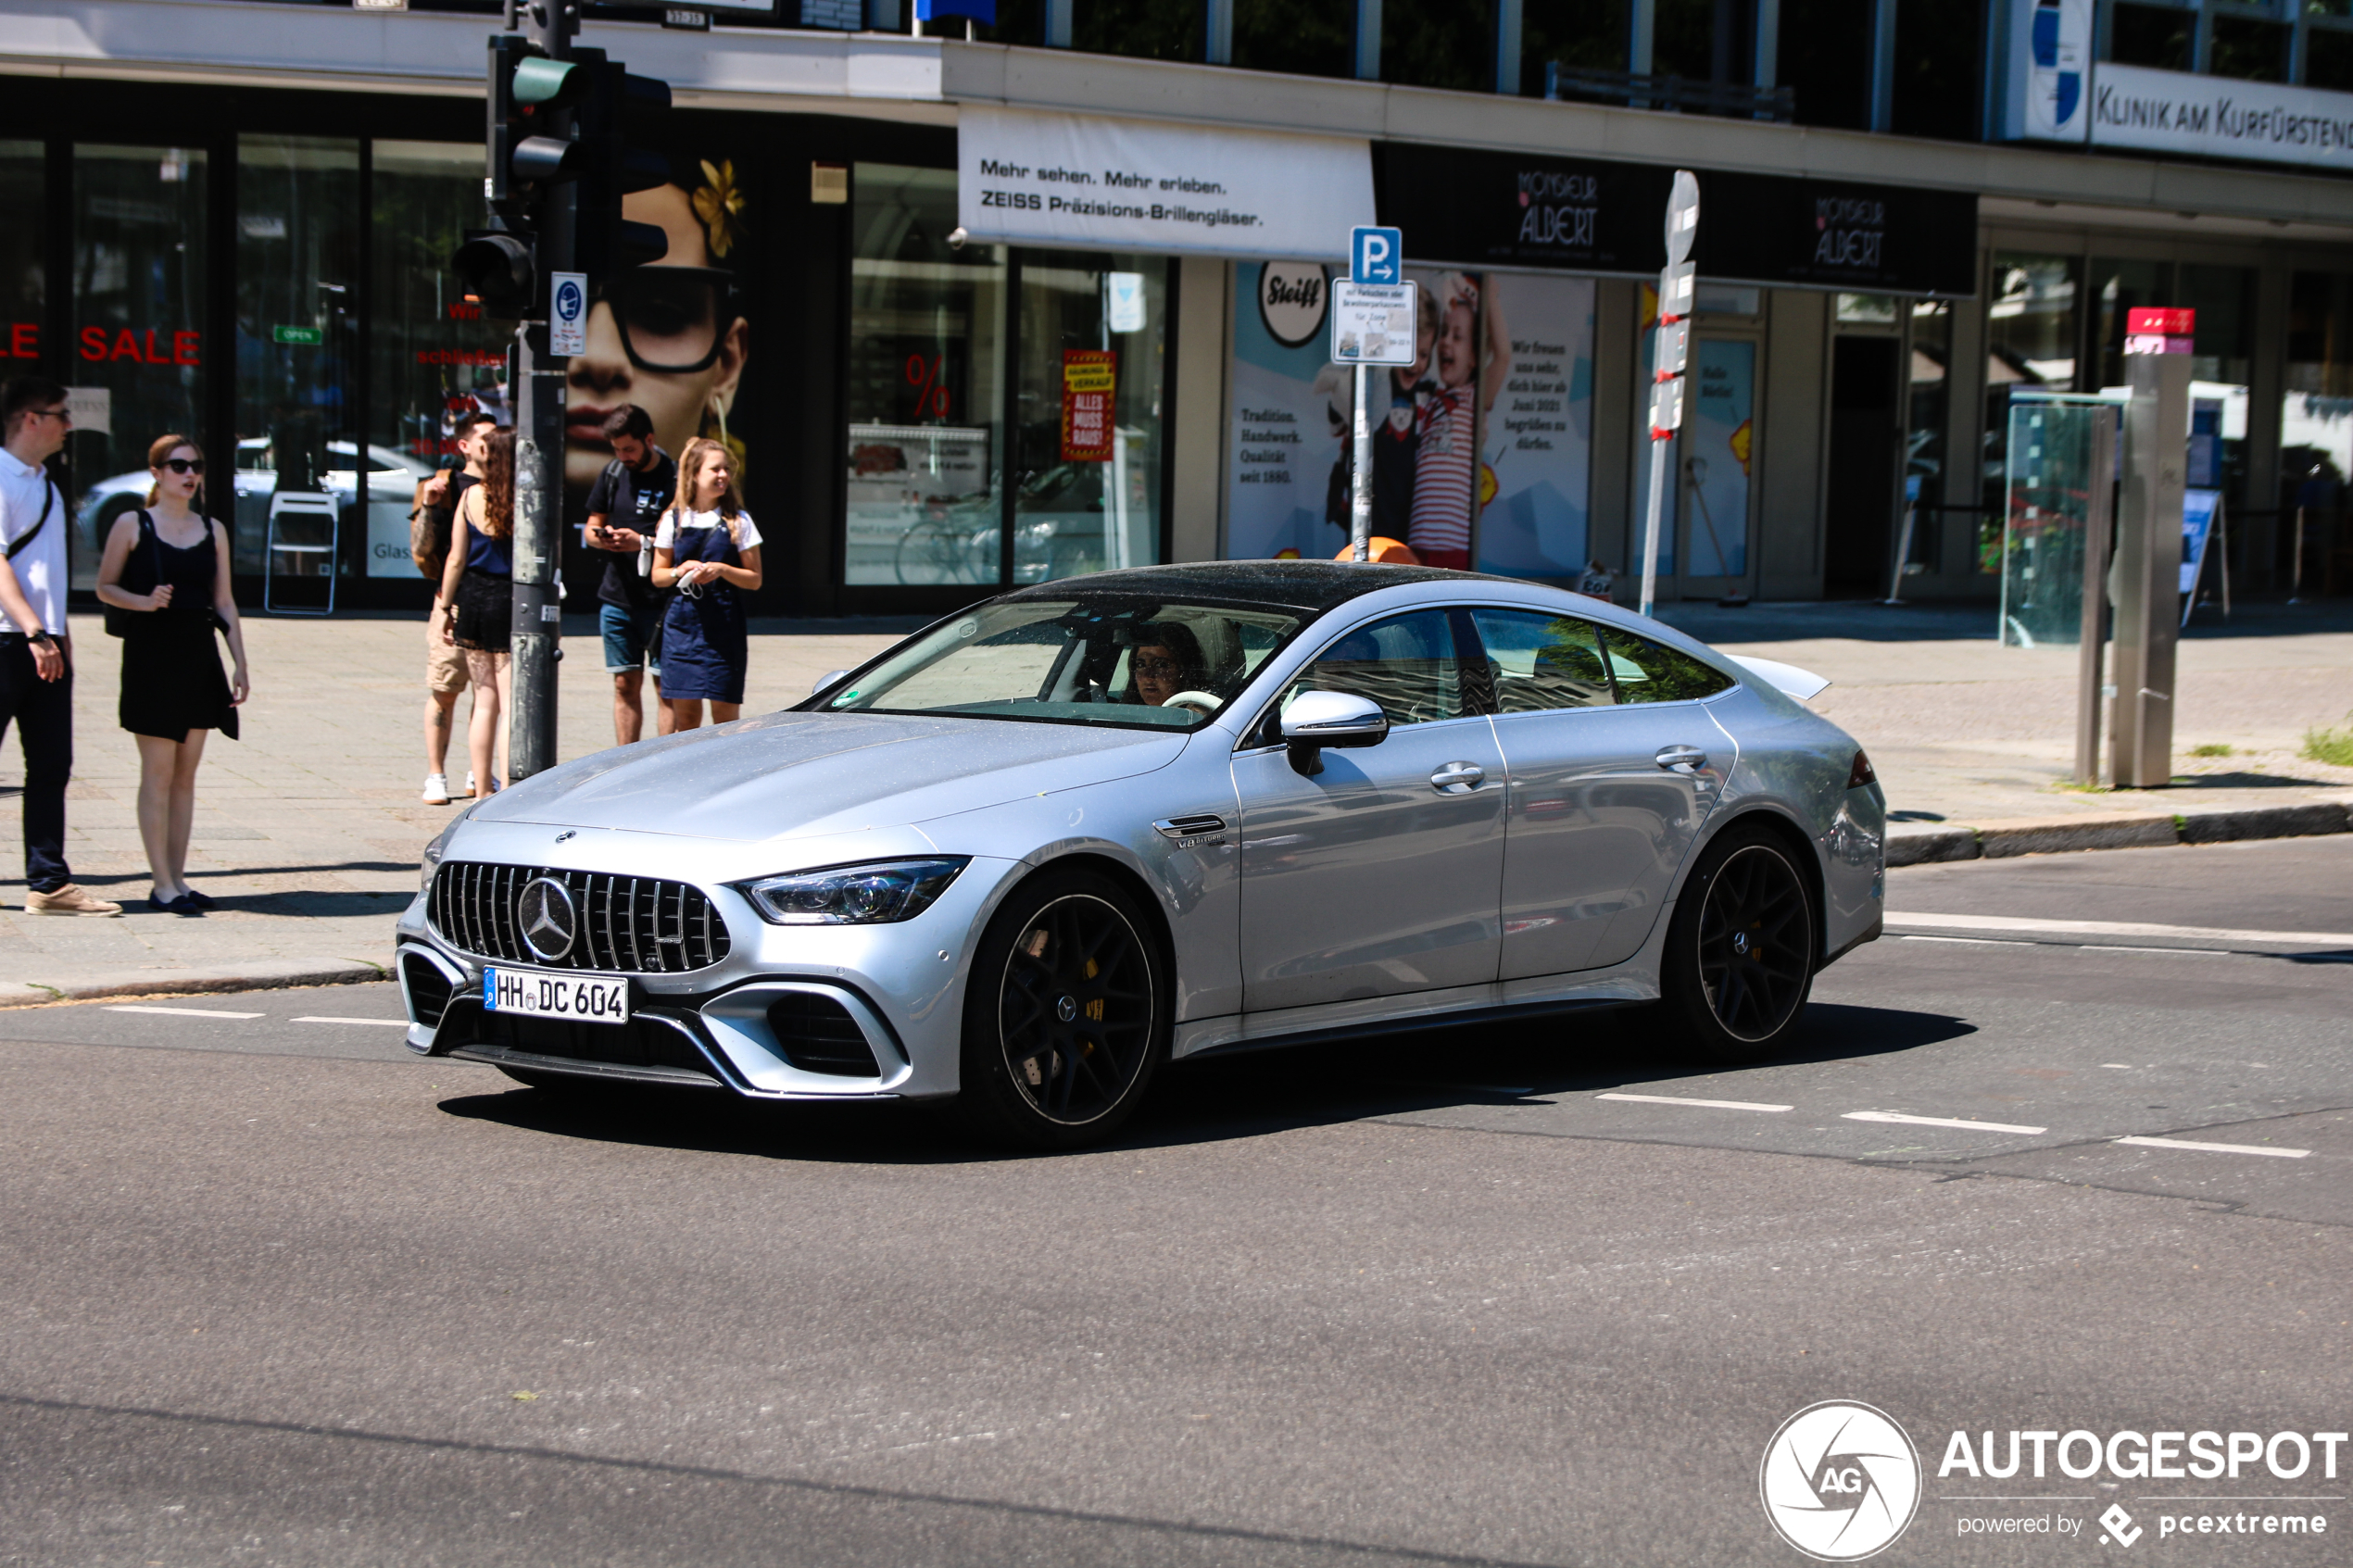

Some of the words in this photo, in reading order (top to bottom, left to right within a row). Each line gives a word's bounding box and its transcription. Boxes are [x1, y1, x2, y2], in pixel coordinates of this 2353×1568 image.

[2096, 83, 2171, 131] KLINIK
[2174, 101, 2210, 134] AM
[980, 159, 1030, 178] Mehr
[1038, 165, 1097, 185] sehen.
[1105, 170, 1152, 189] Mehr
[1159, 177, 1227, 195] erleben.
[981, 191, 1042, 210] ZEISS
[1049, 196, 1264, 227] Präzisions-Brillengläser.
[1518, 205, 1598, 246] ALBERT
[1363, 234, 1390, 279] P
[1814, 229, 1885, 268] ALBERT
[1266, 275, 1322, 308] Steiff
[447, 303, 483, 320] Wir
[283, 329, 313, 342] OPEN
[79, 325, 201, 366] SALE
[1512, 340, 1530, 353] Wir
[1532, 340, 1566, 355] freuen
[1515, 363, 1533, 373] uns
[1074, 375, 1112, 388] VERKAUF
[1507, 378, 1529, 392] dich
[1531, 379, 1553, 393] hier
[1554, 380, 1567, 394] ab
[1075, 394, 1103, 410] ALLES
[1512, 398, 1535, 412] Juni
[1073, 411, 1103, 429] MUSS
[1241, 408, 1297, 423] Tradition.
[1504, 416, 1552, 434] begrüßen
[1554, 421, 1567, 432] zu
[1073, 429, 1103, 445] RAUS!
[1240, 429, 1302, 444] Handwerk.
[1239, 449, 1286, 464] Qualität
[1239, 471, 1260, 483] seit
[1176, 839, 1196, 849] V8
[497, 973, 523, 1008] HH
[538, 979, 569, 1013] DC
[574, 982, 623, 1018] 604
